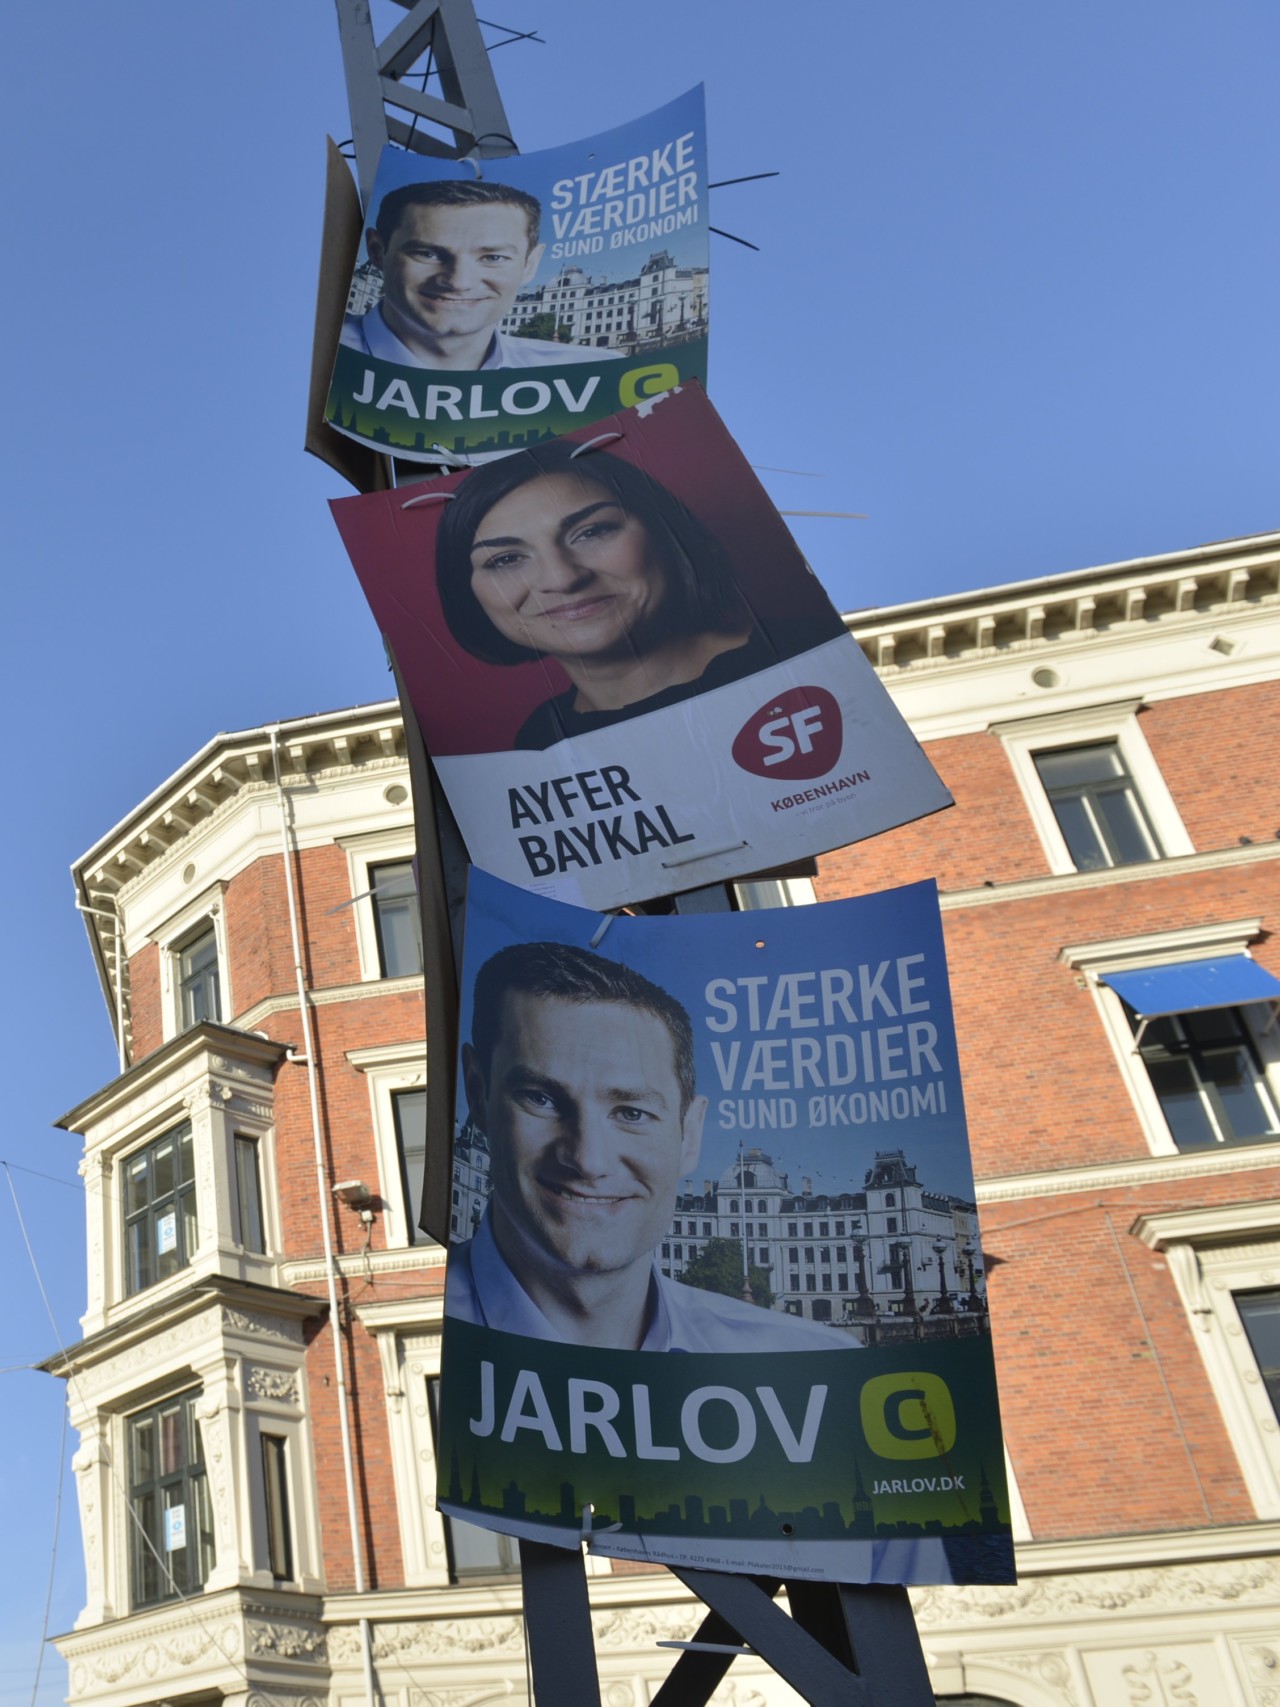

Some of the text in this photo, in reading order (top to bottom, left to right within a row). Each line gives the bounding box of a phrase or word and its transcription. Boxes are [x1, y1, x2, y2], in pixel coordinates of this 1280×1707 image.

[550, 130, 695, 210] STÆRKE
[550, 203, 698, 259] SUND ØKONOMI
[551, 171, 699, 240] VÆRDIER
[352, 369, 601, 421] JARLOV
[758, 704, 823, 767] SF
[507, 764, 642, 829] AYFER
[770, 769, 871, 812] KØBENHAVN
[519, 803, 696, 878] BAYKAL
[704, 952, 931, 1033] STÆRKE
[710, 1020, 944, 1092] VÆRDIER
[718, 1080, 948, 1130] SUND ØKONOMI
[469, 1360, 828, 1464] JARLOV
[872, 1475, 966, 1495] JARLOV.DK
